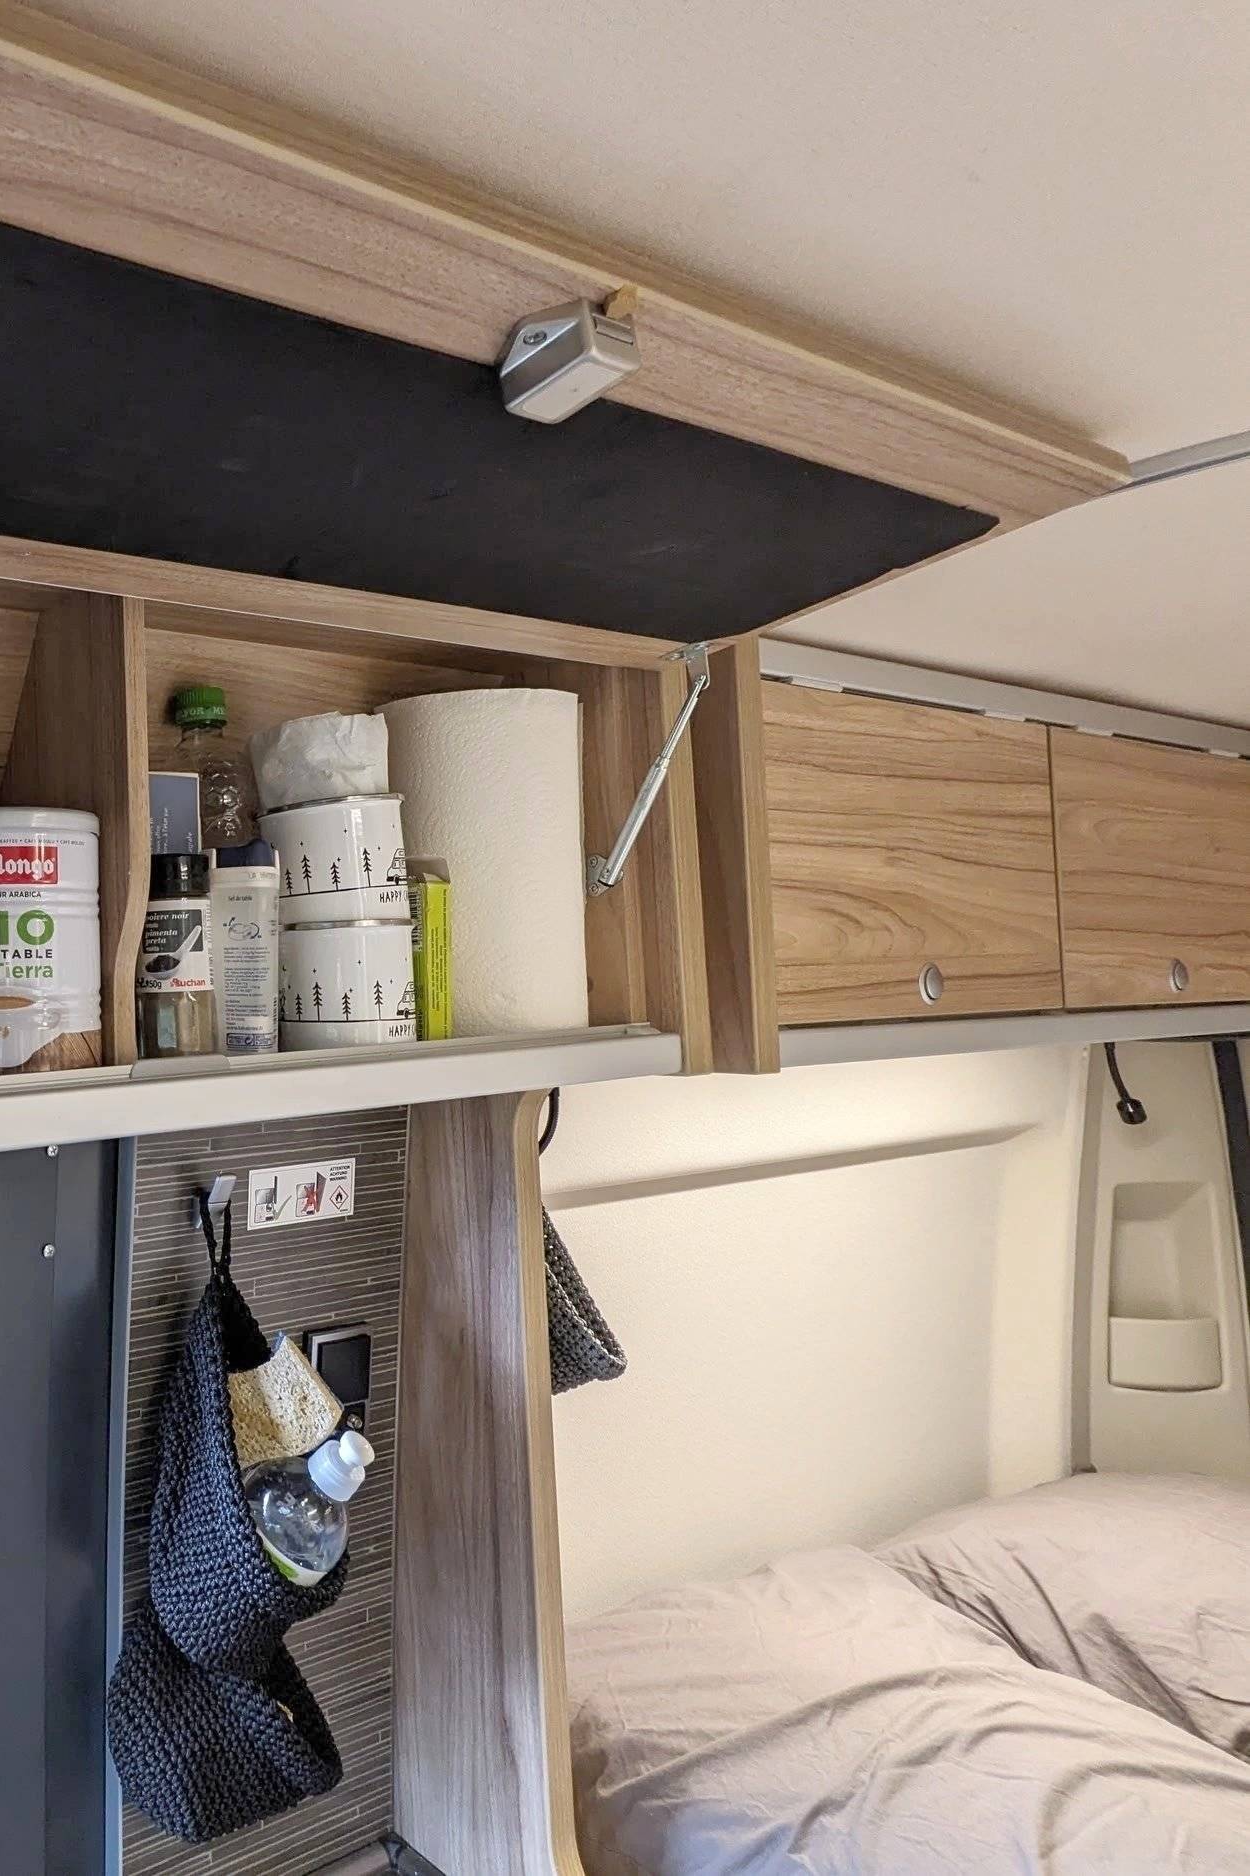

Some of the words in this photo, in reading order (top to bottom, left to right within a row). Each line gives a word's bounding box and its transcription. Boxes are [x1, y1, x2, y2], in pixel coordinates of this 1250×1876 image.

[8, 890, 42, 898] ARABICA
[379, 890, 402, 903] HAPPY
[171, 911, 189, 920] noir
[145, 929, 178, 938] pimenta
[388, 1025, 411, 1038] HAPPY
